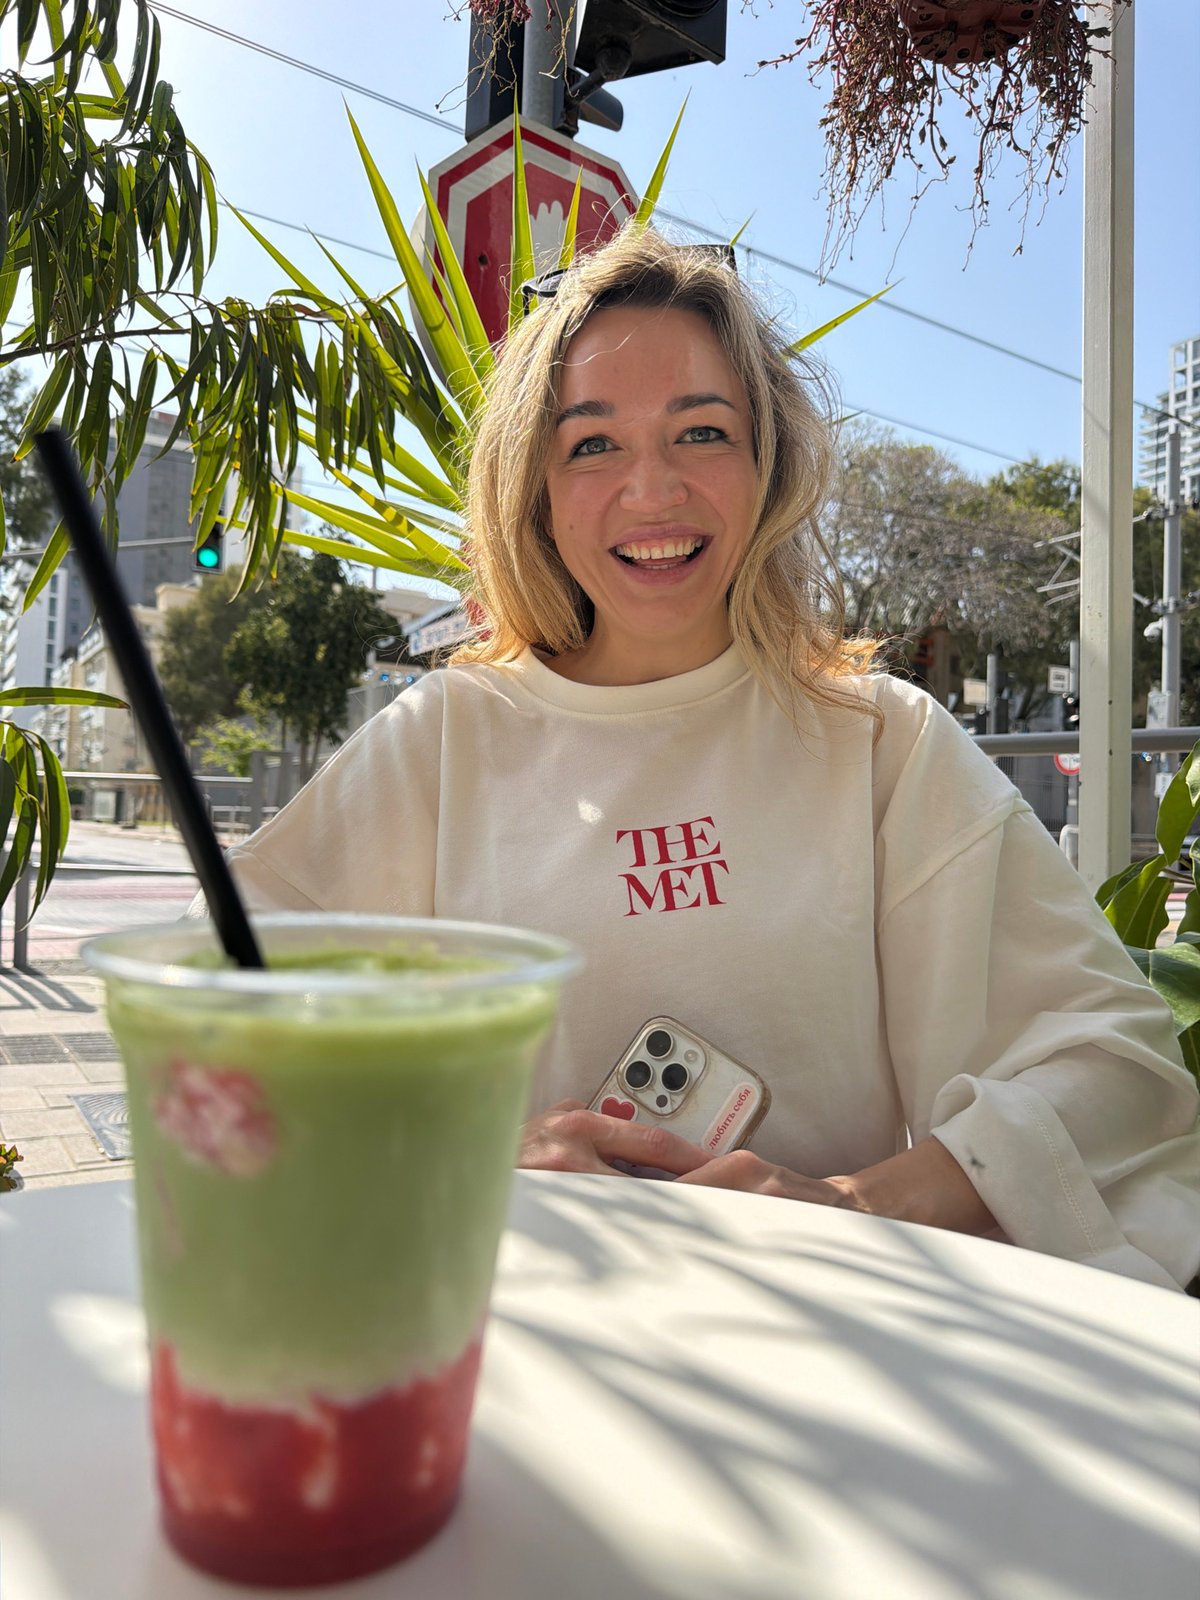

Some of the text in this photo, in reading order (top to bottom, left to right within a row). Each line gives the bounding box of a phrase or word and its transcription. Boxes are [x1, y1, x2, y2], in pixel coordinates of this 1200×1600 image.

[616, 816, 721, 868] THE
[617, 859, 730, 917] MET
[708, 1088, 751, 1150] любить себя
